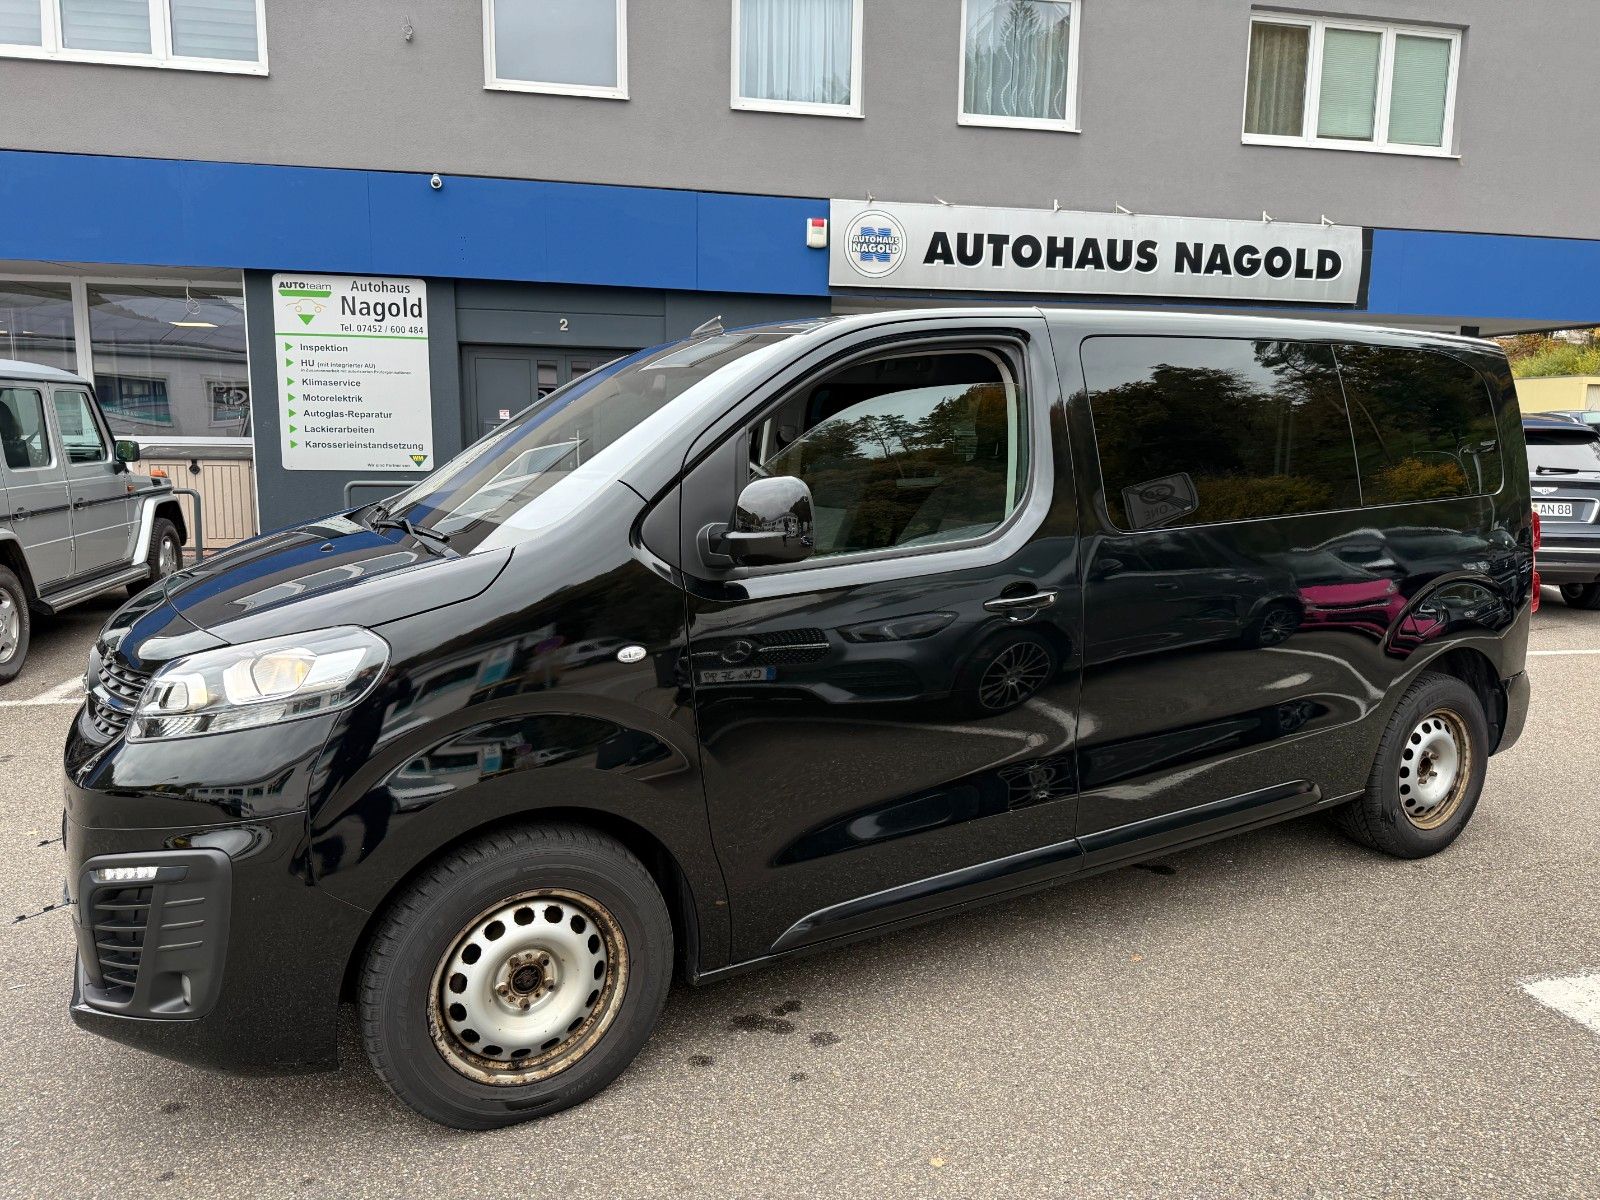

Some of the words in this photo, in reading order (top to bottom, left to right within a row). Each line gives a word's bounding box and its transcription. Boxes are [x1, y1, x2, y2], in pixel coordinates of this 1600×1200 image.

[852, 234, 901, 244] AUTOHAUS
[851, 242, 901, 254] NAGOLD
[922, 231, 1159, 273] AUTOHAUS
[1174, 241, 1343, 280] NAGOLD
[278, 281, 332, 291] AUTOteam
[350, 280, 411, 294] Autohaus
[340, 295, 423, 322] Nagold
[340, 323, 355, 332] Tel.
[356, 324, 382, 333] 07452
[390, 325, 406, 333] 600
[408, 325, 424, 334] 484
[559, 318, 569, 331] 2
[300, 343, 349, 353] Inspektion
[301, 359, 315, 367] HU
[301, 378, 361, 387] Klimaservice
[302, 393, 363, 403] Motorelektrik
[303, 409, 393, 420] Autoglas-Reparatur
[304, 425, 375, 434] Lackierarbeiten
[305, 440, 424, 451] Karosserieinstandsetzung
[1540, 504, 1555, 515] AN
[1557, 504, 1571, 515] 88
